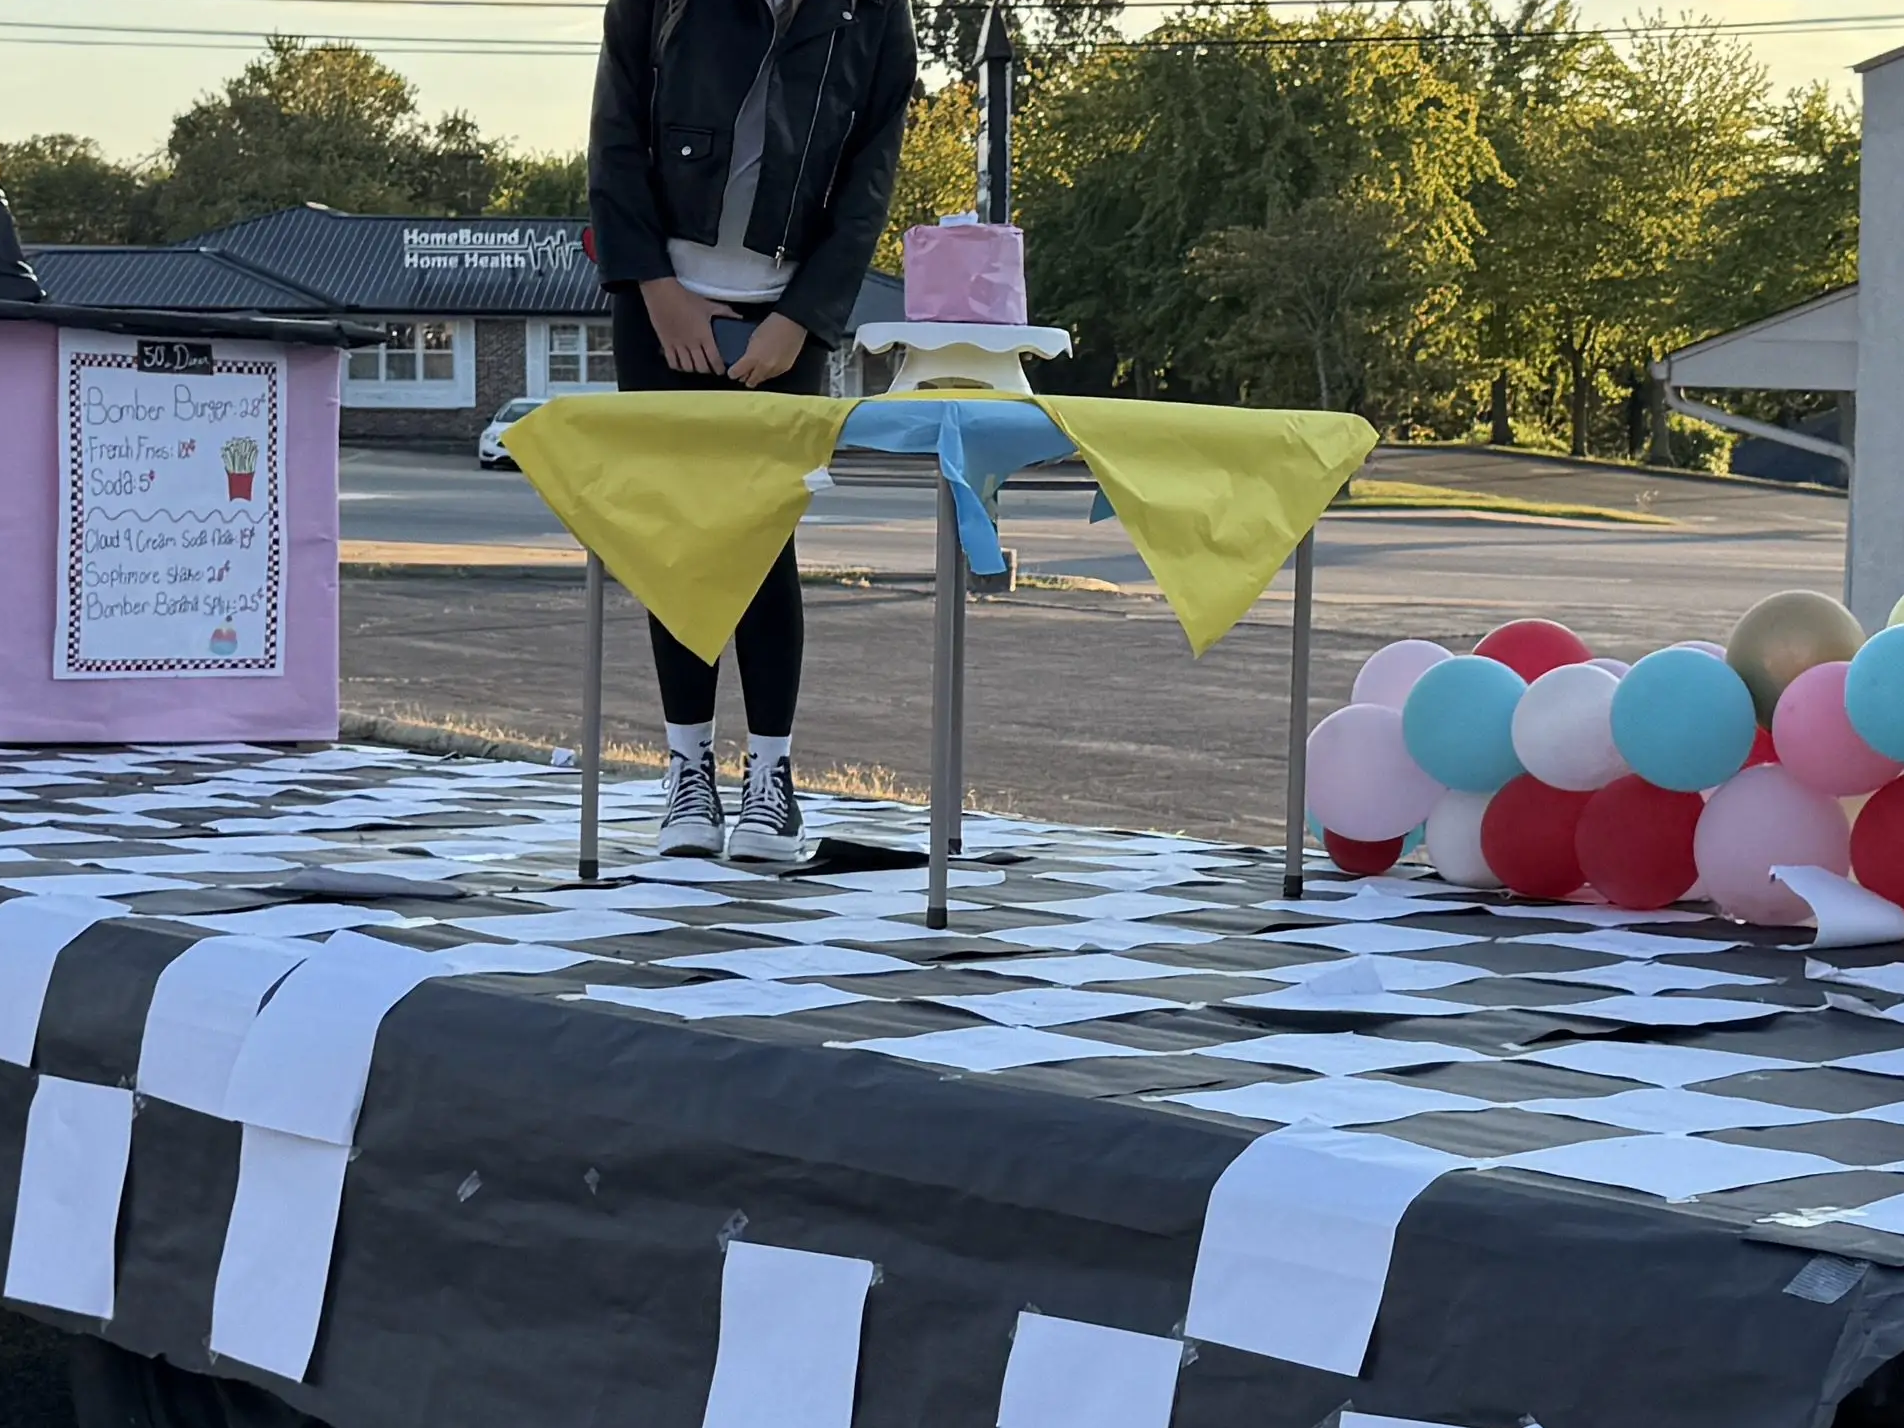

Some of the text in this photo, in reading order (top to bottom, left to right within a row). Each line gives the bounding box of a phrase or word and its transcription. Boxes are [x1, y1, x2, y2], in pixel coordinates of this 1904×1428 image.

[403, 228, 520, 245] HomeBound
[404, 252, 526, 269] Home Health
[86, 386, 165, 425] Bomber
[88, 435, 133, 463] French
[136, 529, 176, 553] Cream
